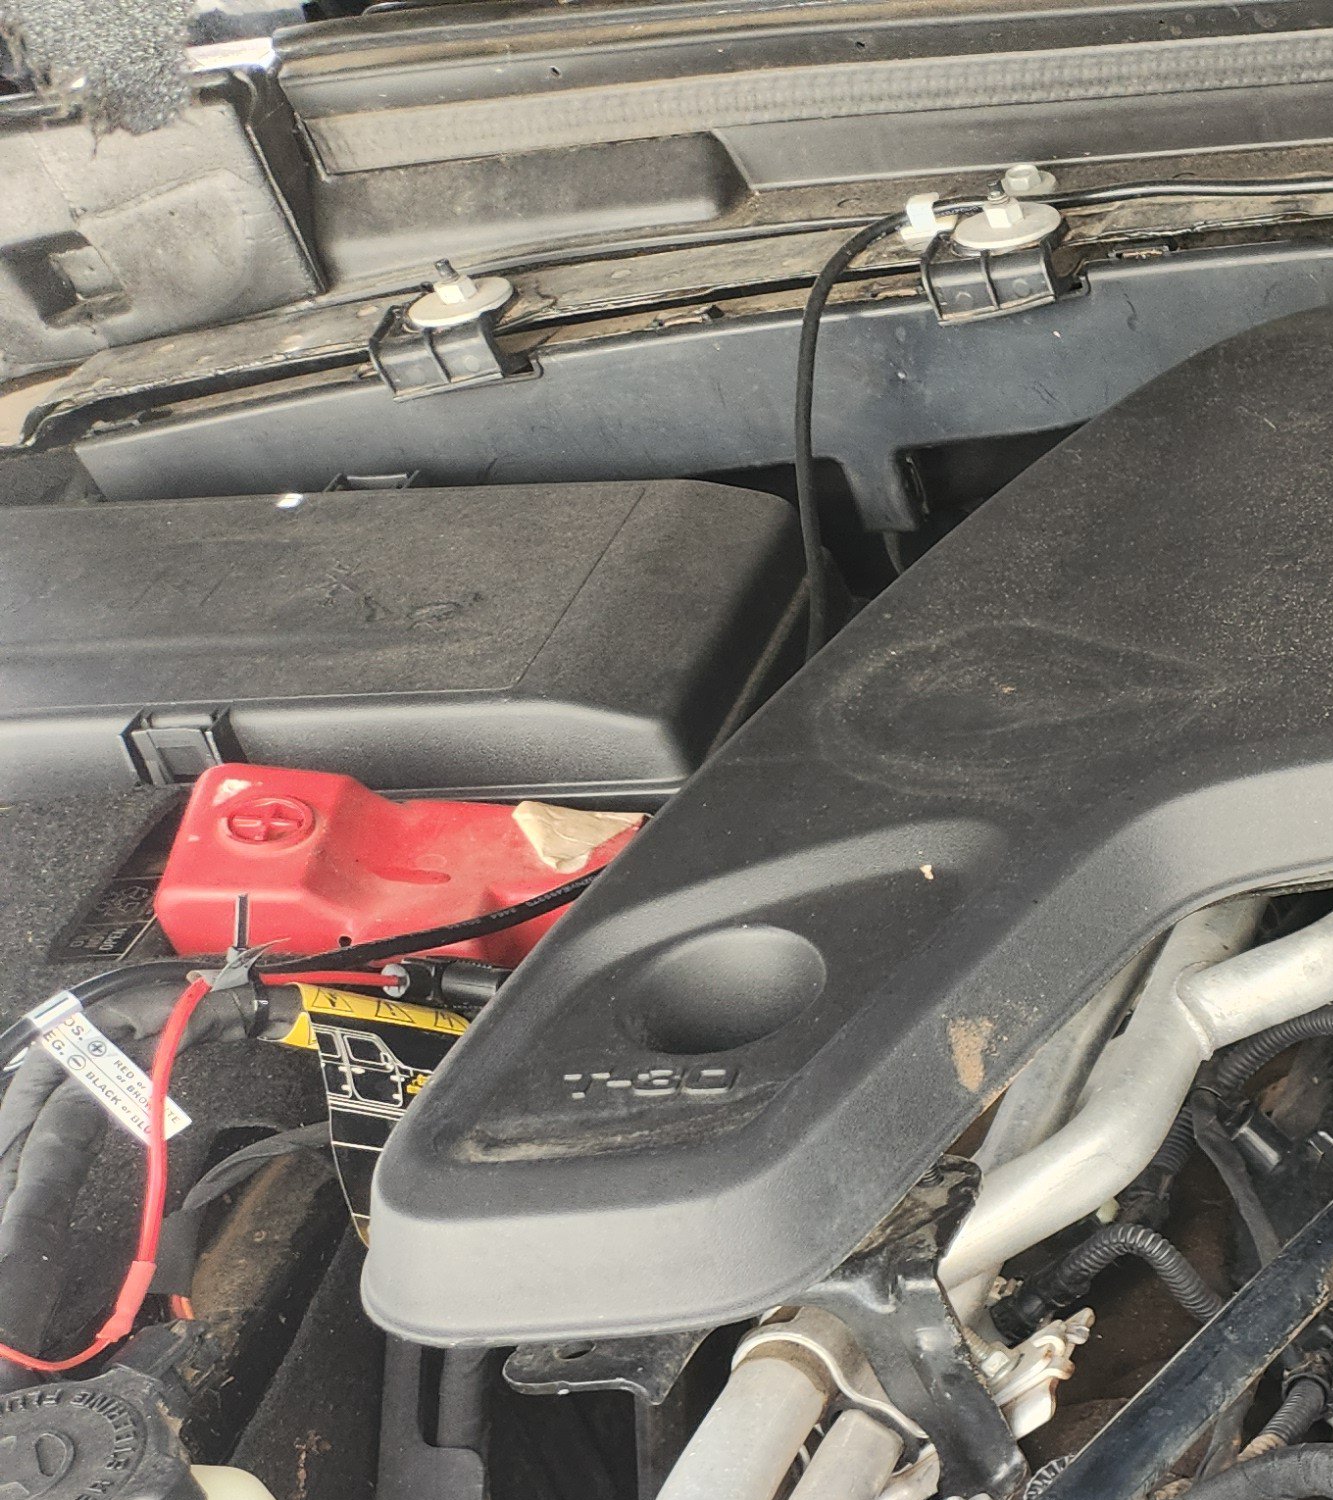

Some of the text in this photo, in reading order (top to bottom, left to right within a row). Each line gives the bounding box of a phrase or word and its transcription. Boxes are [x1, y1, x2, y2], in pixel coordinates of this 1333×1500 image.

[42, 1030, 65, 1056] EG.
[85, 1071, 122, 1105] BLACK
[63, 1017, 85, 1041] OS.
[113, 1059, 135, 1079] RED
[126, 1084, 152, 1111] BRO
[562, 1066, 742, 1101] T-30
